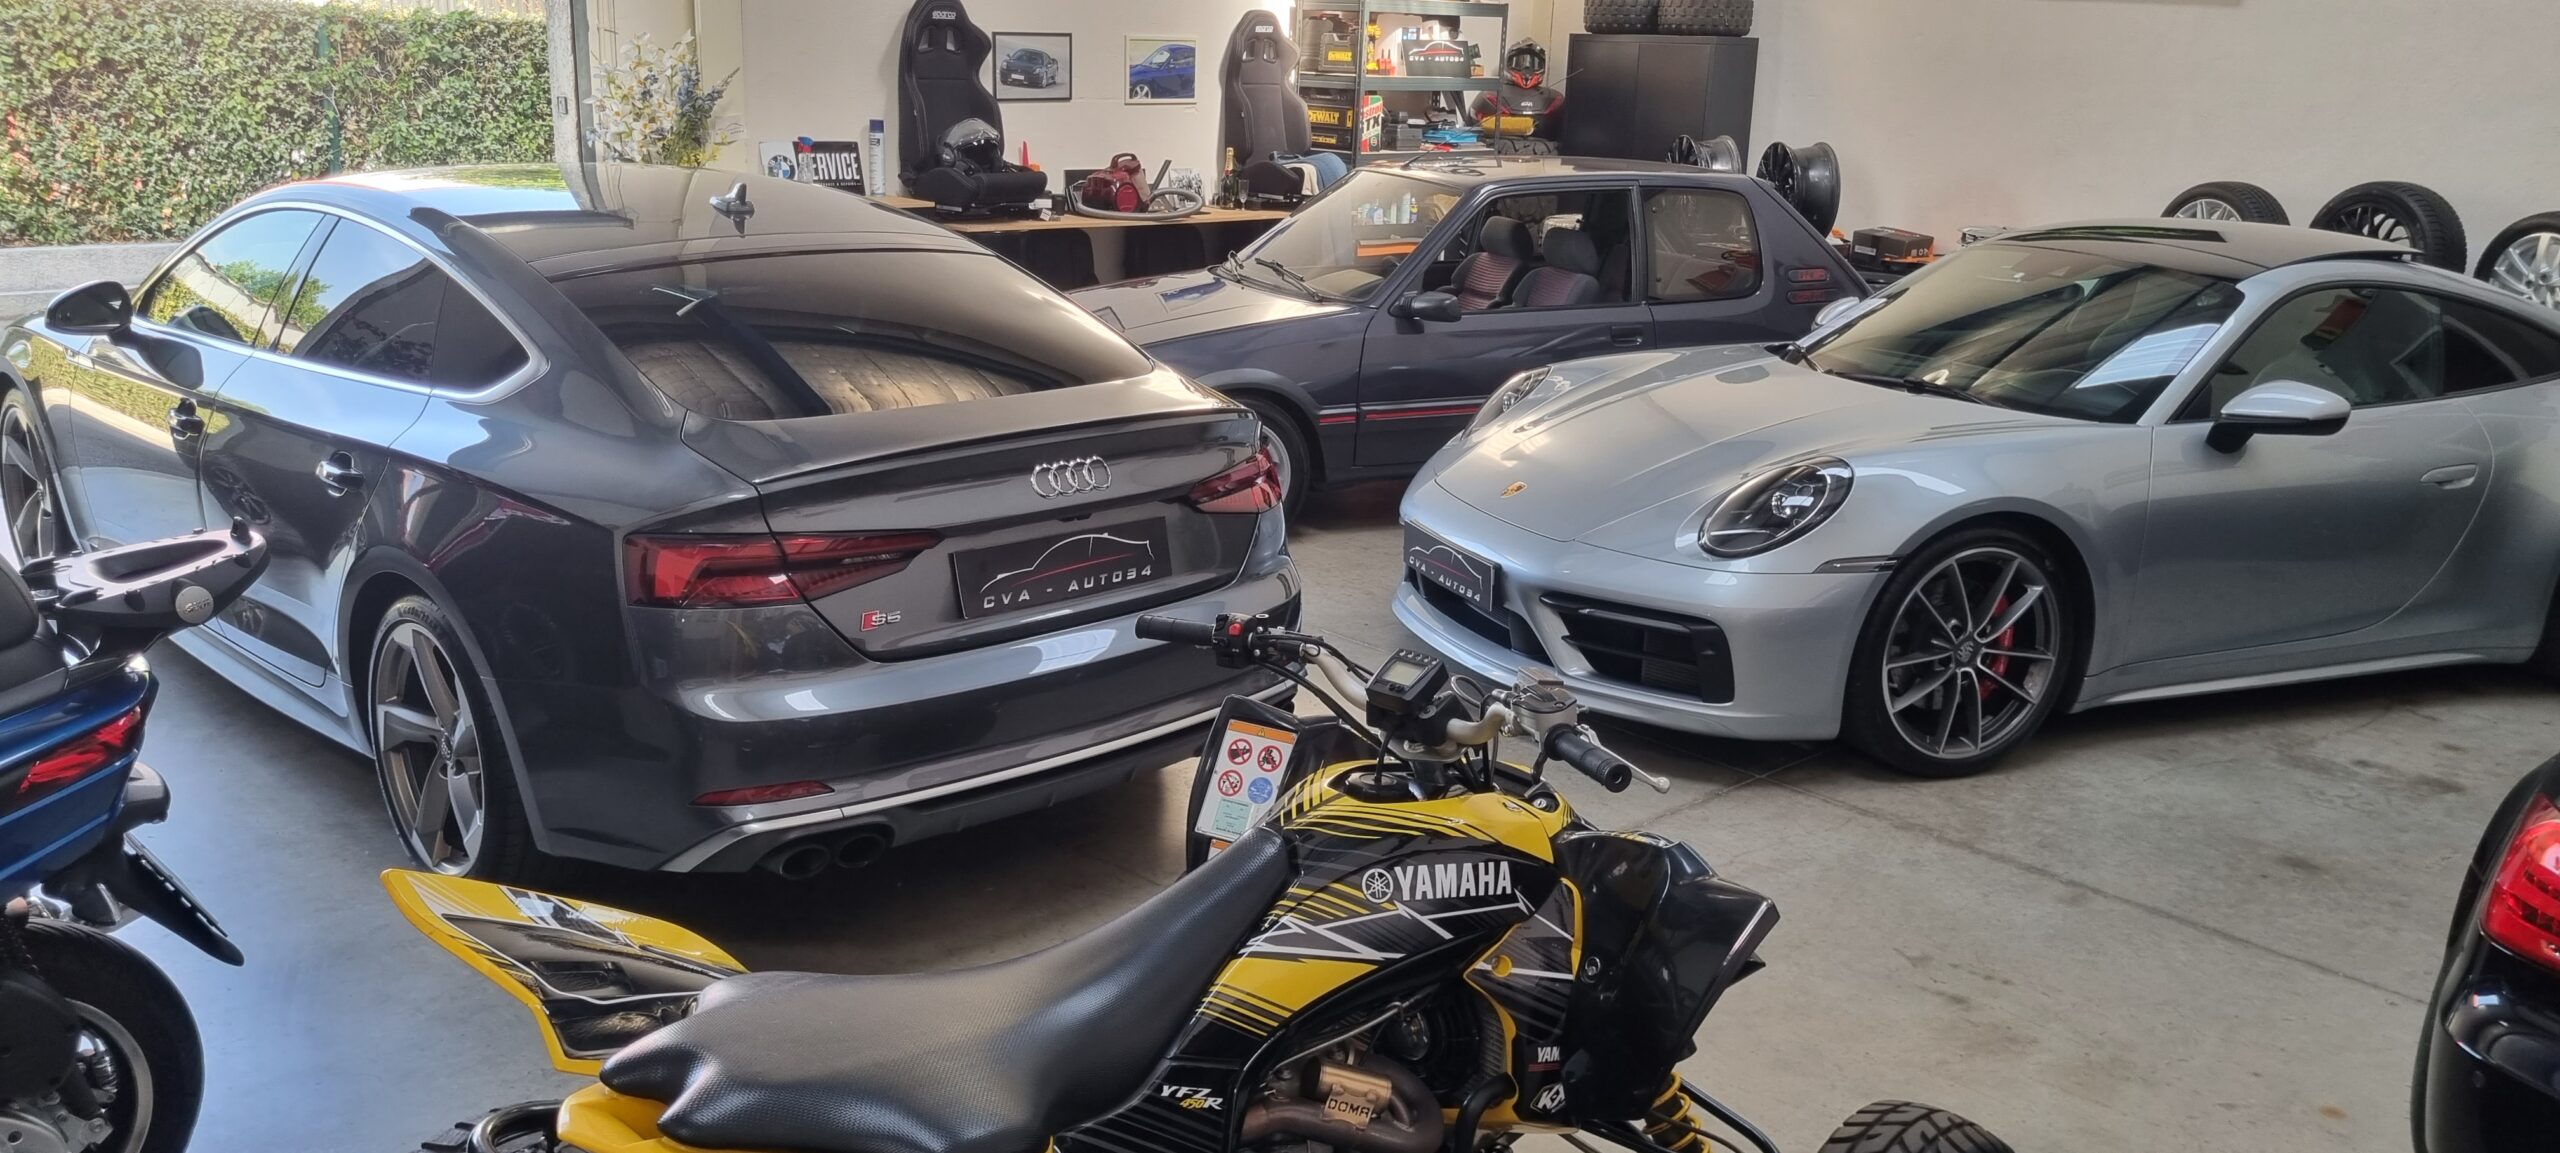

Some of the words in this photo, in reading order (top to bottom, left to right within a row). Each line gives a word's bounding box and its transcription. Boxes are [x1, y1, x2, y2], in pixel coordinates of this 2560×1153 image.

[983, 589, 1031, 609] CVA
[1067, 564, 1152, 592] AUTO34
[1409, 555, 1427, 573] CVA
[1438, 574, 1481, 602] AUTO34
[1394, 861, 1512, 901] YAMAHA
[1537, 1046, 1560, 1063] YAM
[1160, 1085, 1213, 1099] YFZ
[1327, 1098, 1370, 1118] DOMA
